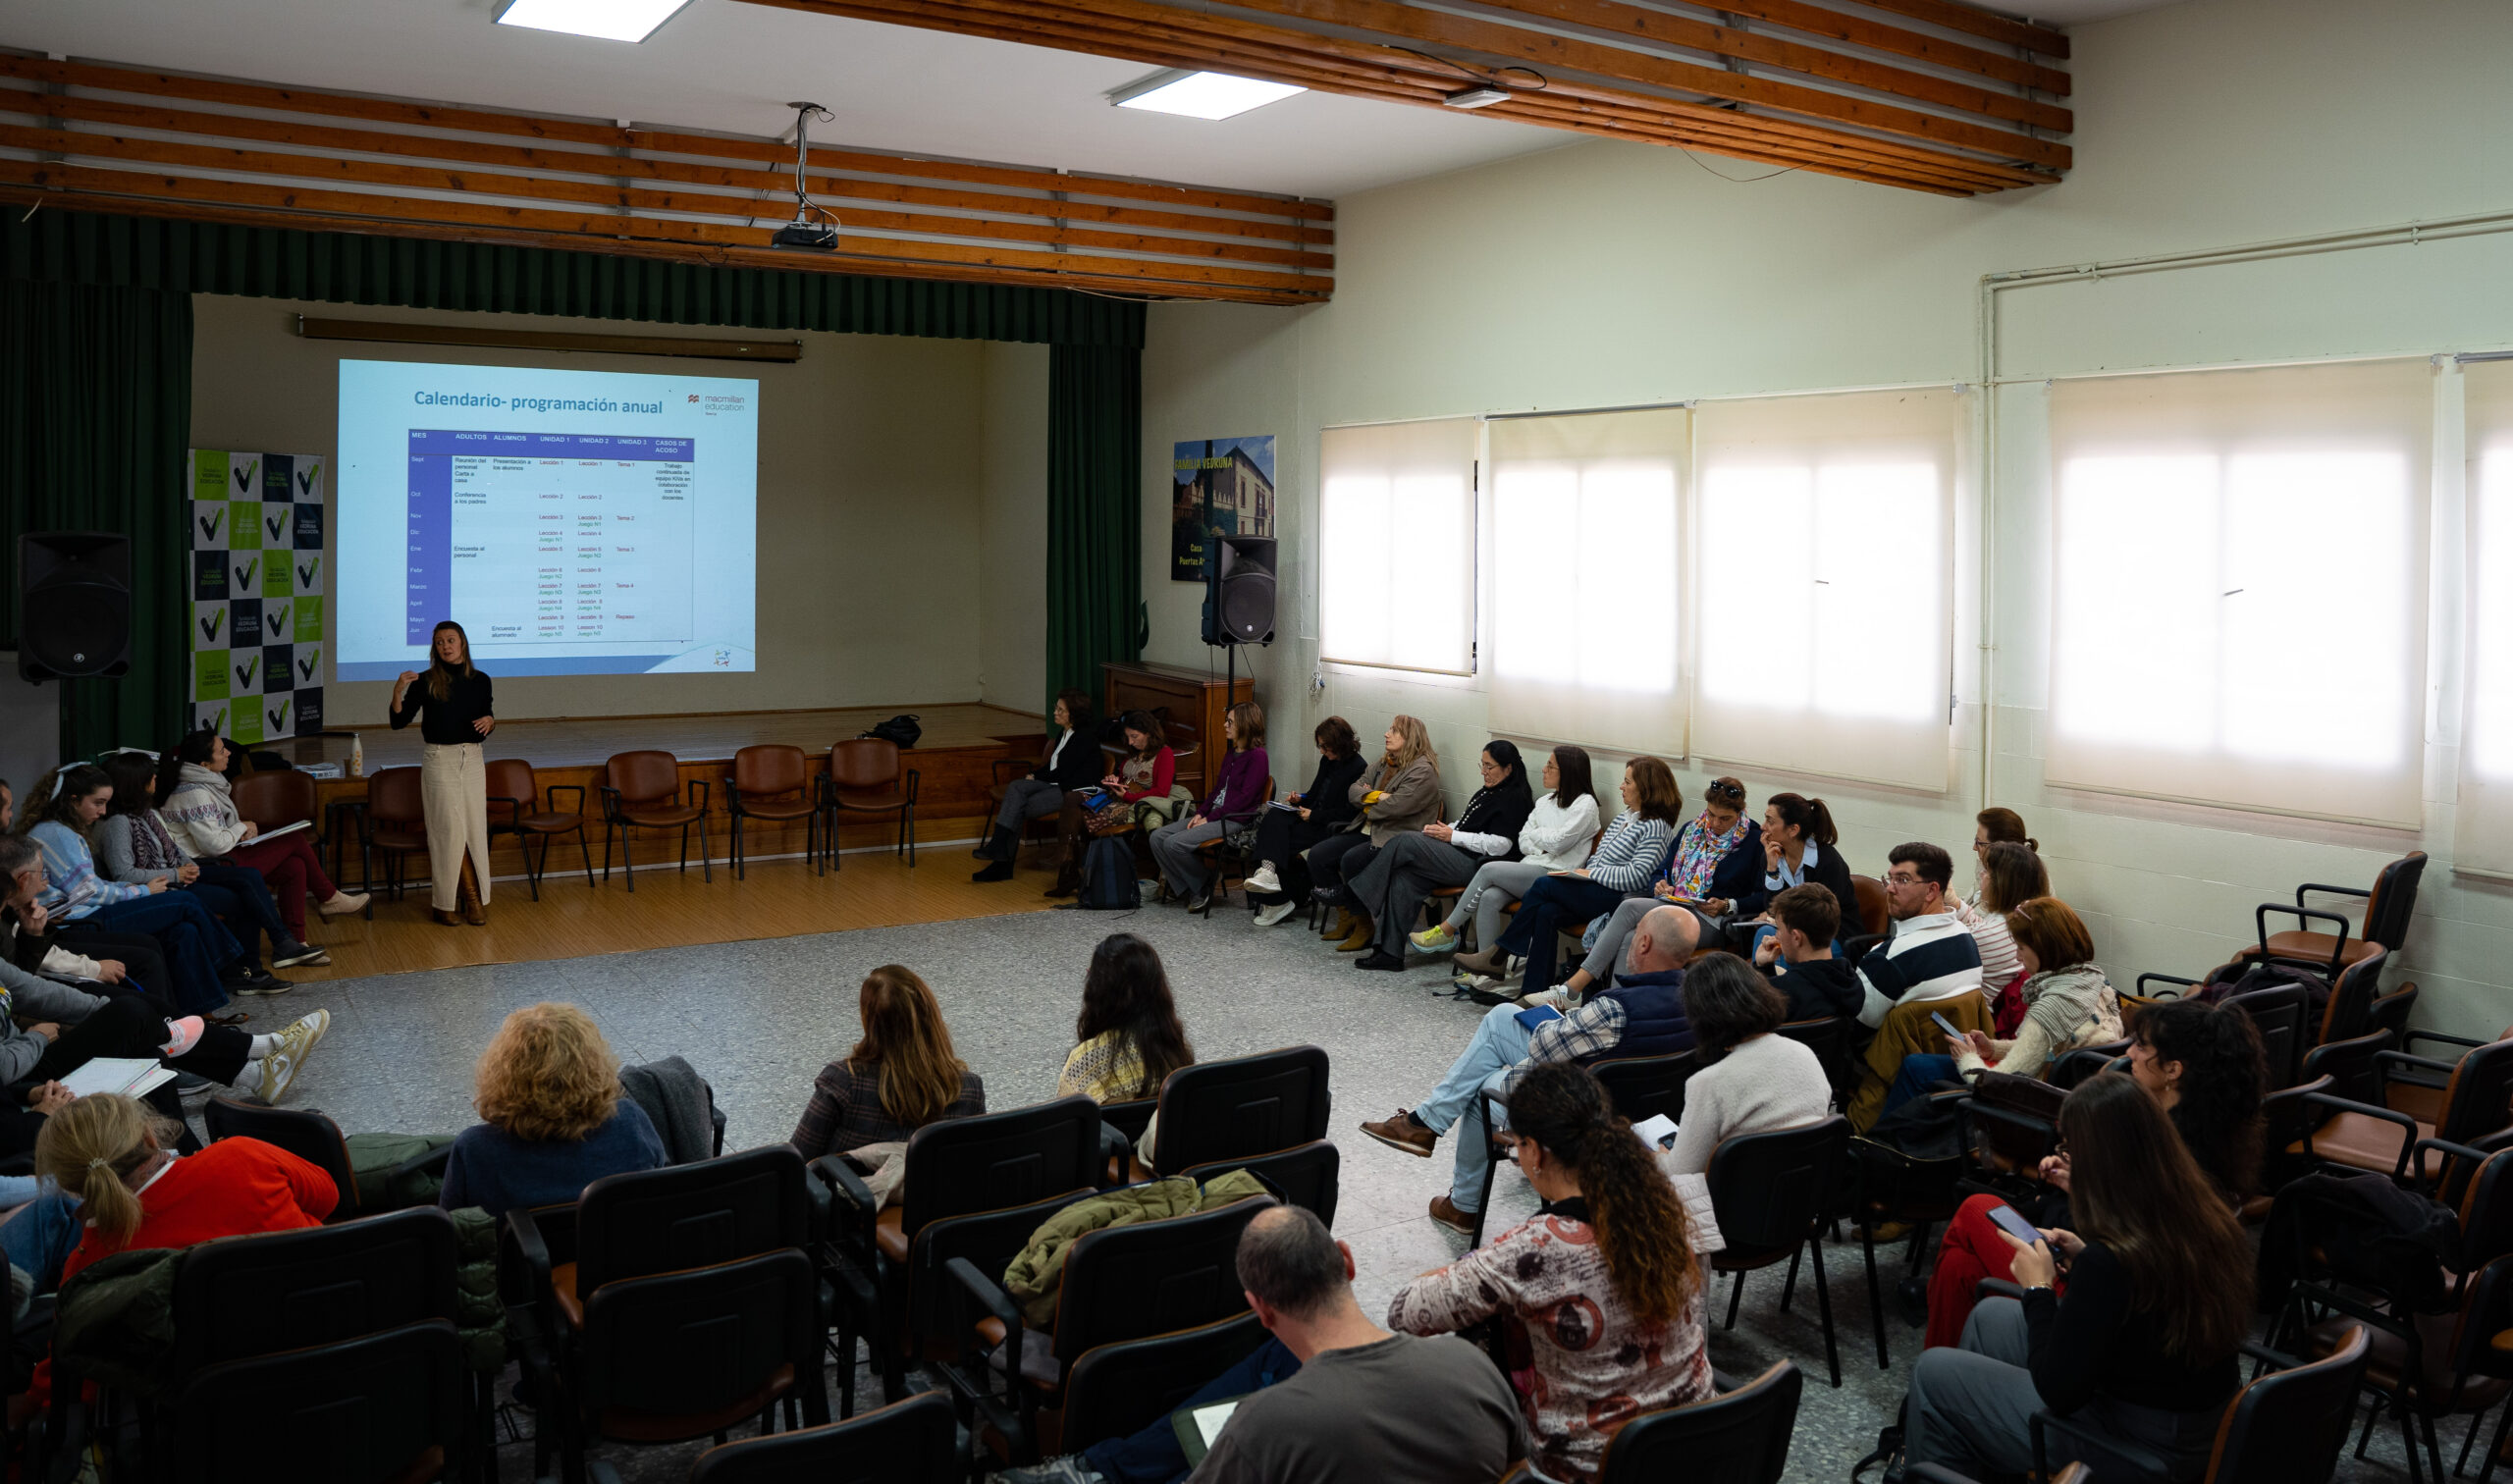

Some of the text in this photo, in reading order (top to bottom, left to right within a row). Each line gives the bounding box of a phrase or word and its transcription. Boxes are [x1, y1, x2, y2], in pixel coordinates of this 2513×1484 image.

[414, 391, 663, 414] Calendario- programación anual
[705, 395, 745, 403] macmillan
[1203, 456, 1233, 469] VEDRUNA
[1179, 557, 1198, 566] Puertas
